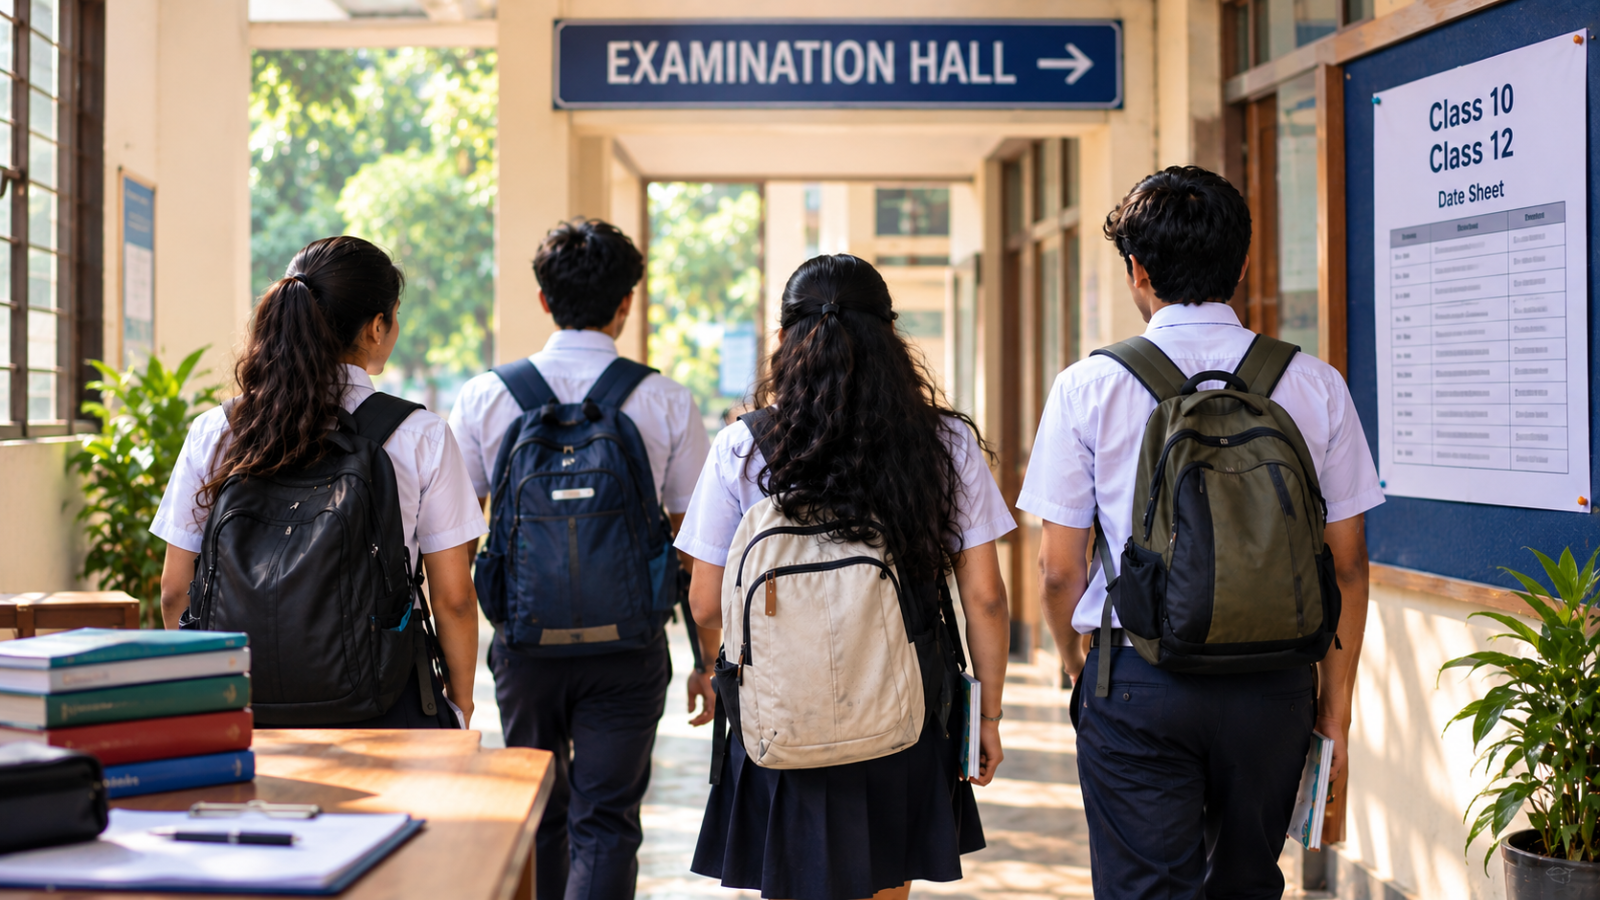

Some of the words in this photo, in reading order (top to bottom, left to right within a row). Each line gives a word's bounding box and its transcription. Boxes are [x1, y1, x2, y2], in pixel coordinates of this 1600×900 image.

[607, 40, 895, 85] EXAMINATION
[910, 40, 1017, 85] HALL
[1429, 98, 1483, 132] Class
[1490, 83, 1514, 116] 10
[1429, 141, 1483, 173] Class
[1490, 127, 1514, 160] 12
[1438, 188, 1465, 208] Date
[1468, 180, 1505, 202] Sheet
